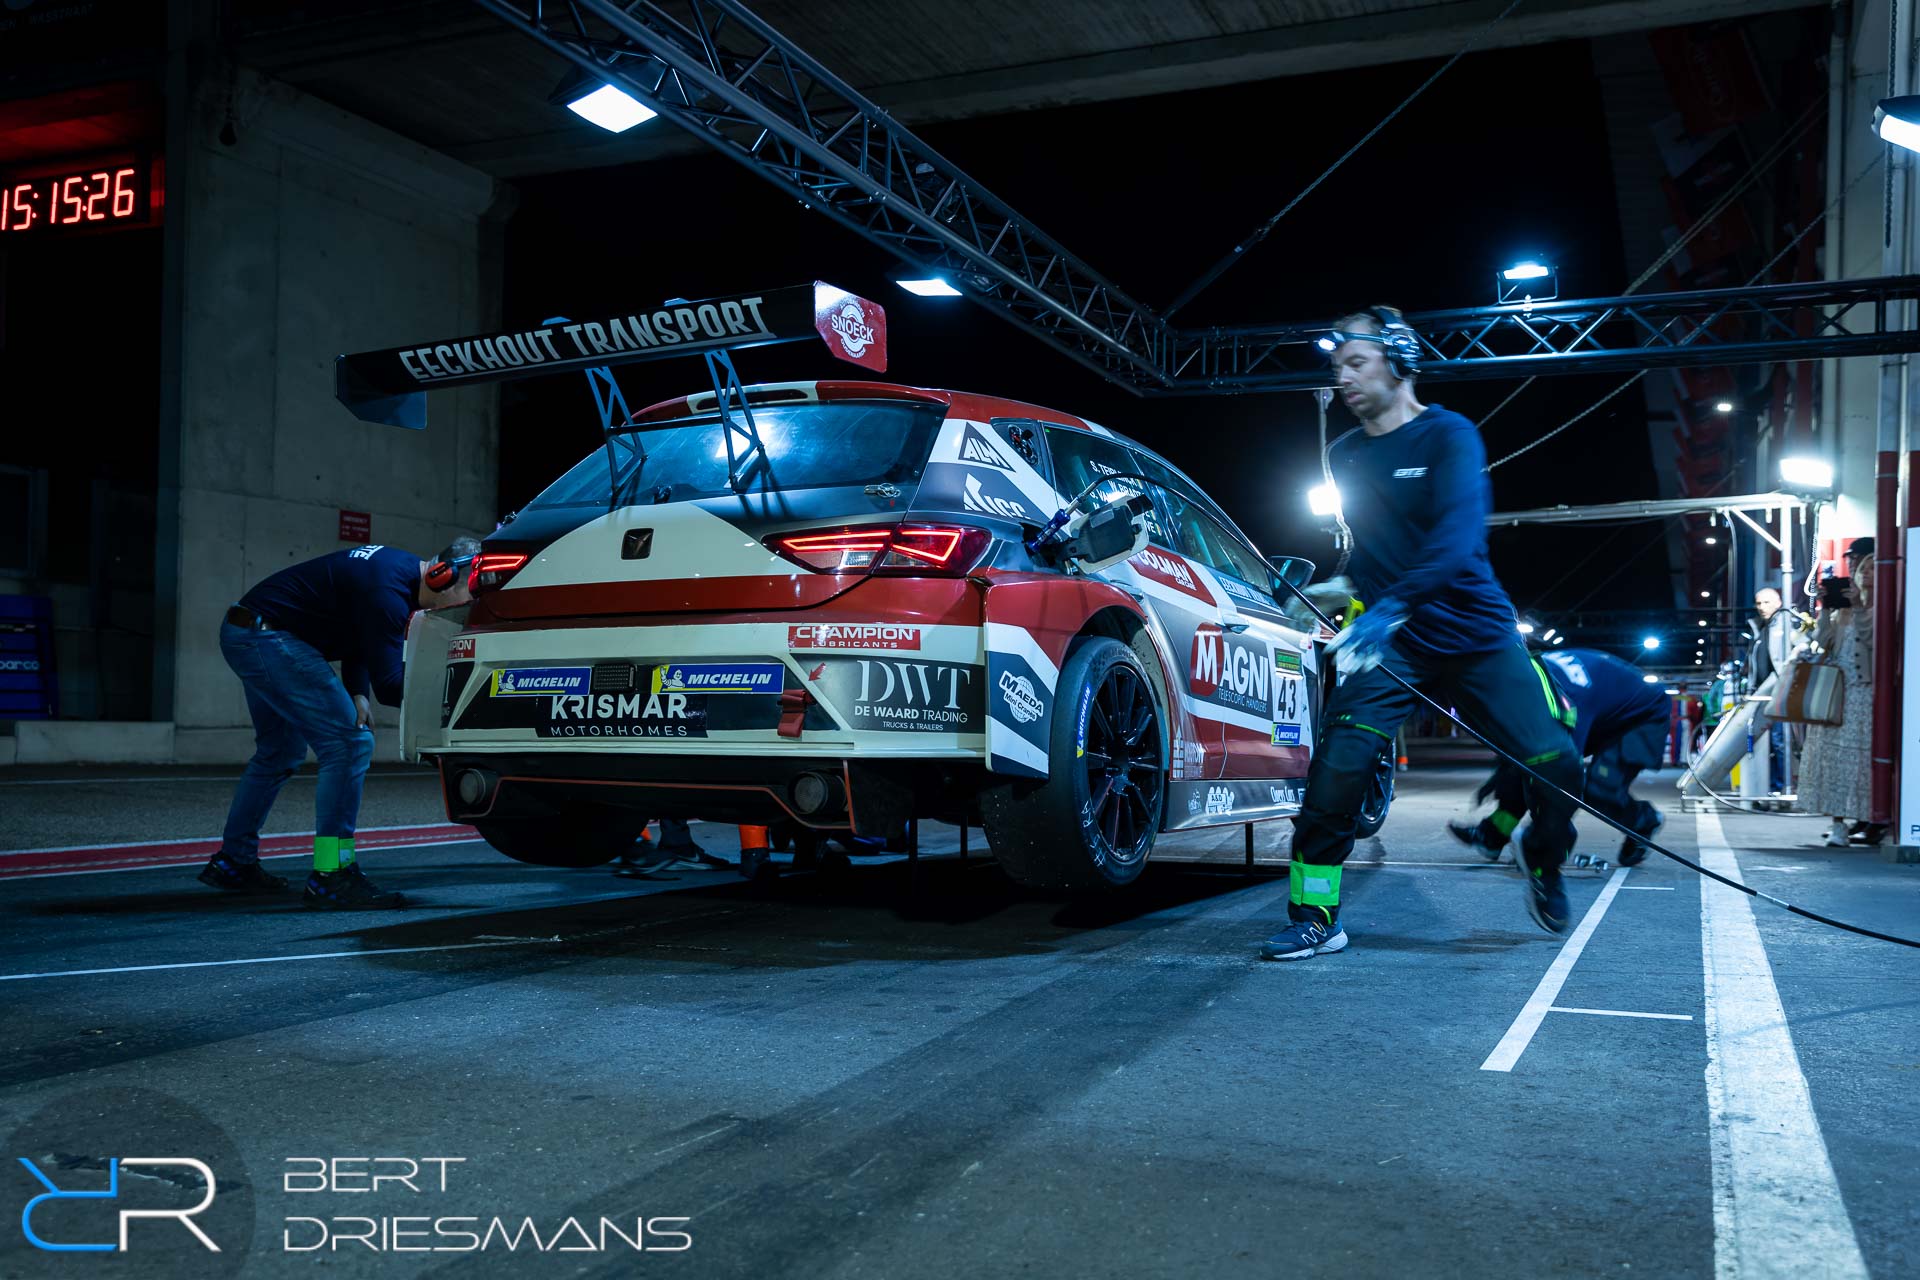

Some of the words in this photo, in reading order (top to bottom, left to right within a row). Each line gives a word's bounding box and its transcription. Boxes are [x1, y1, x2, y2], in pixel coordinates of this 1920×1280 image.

[1, 168, 135, 231] 15:15:26
[399, 328, 562, 380] EECKHOUT
[564, 296, 766, 356] TRANSPORT
[832, 314, 874, 343] SNOECK
[1137, 549, 1194, 583] COLMAN
[796, 626, 915, 641] CHAMPION
[811, 641, 898, 649] LUBRICANTS
[687, 673, 772, 686] MICHELIN
[1195, 632, 1269, 702] MAGNI
[517, 677, 581, 688] MICHELIN
[855, 660, 971, 709] DWT
[1001, 673, 1043, 715] MAEDA
[551, 694, 687, 721] KRISMAR
[1079, 686, 1091, 738] MICHELIN
[1278, 677, 1296, 720] 43
[855, 705, 870, 717] DE
[873, 706, 919, 719] WAARD
[922, 710, 968, 724] TRADING
[883, 720, 908, 730] TRUCKS
[916, 722, 943, 731] TRAILERS
[551, 726, 687, 737] MOTORHOMES
